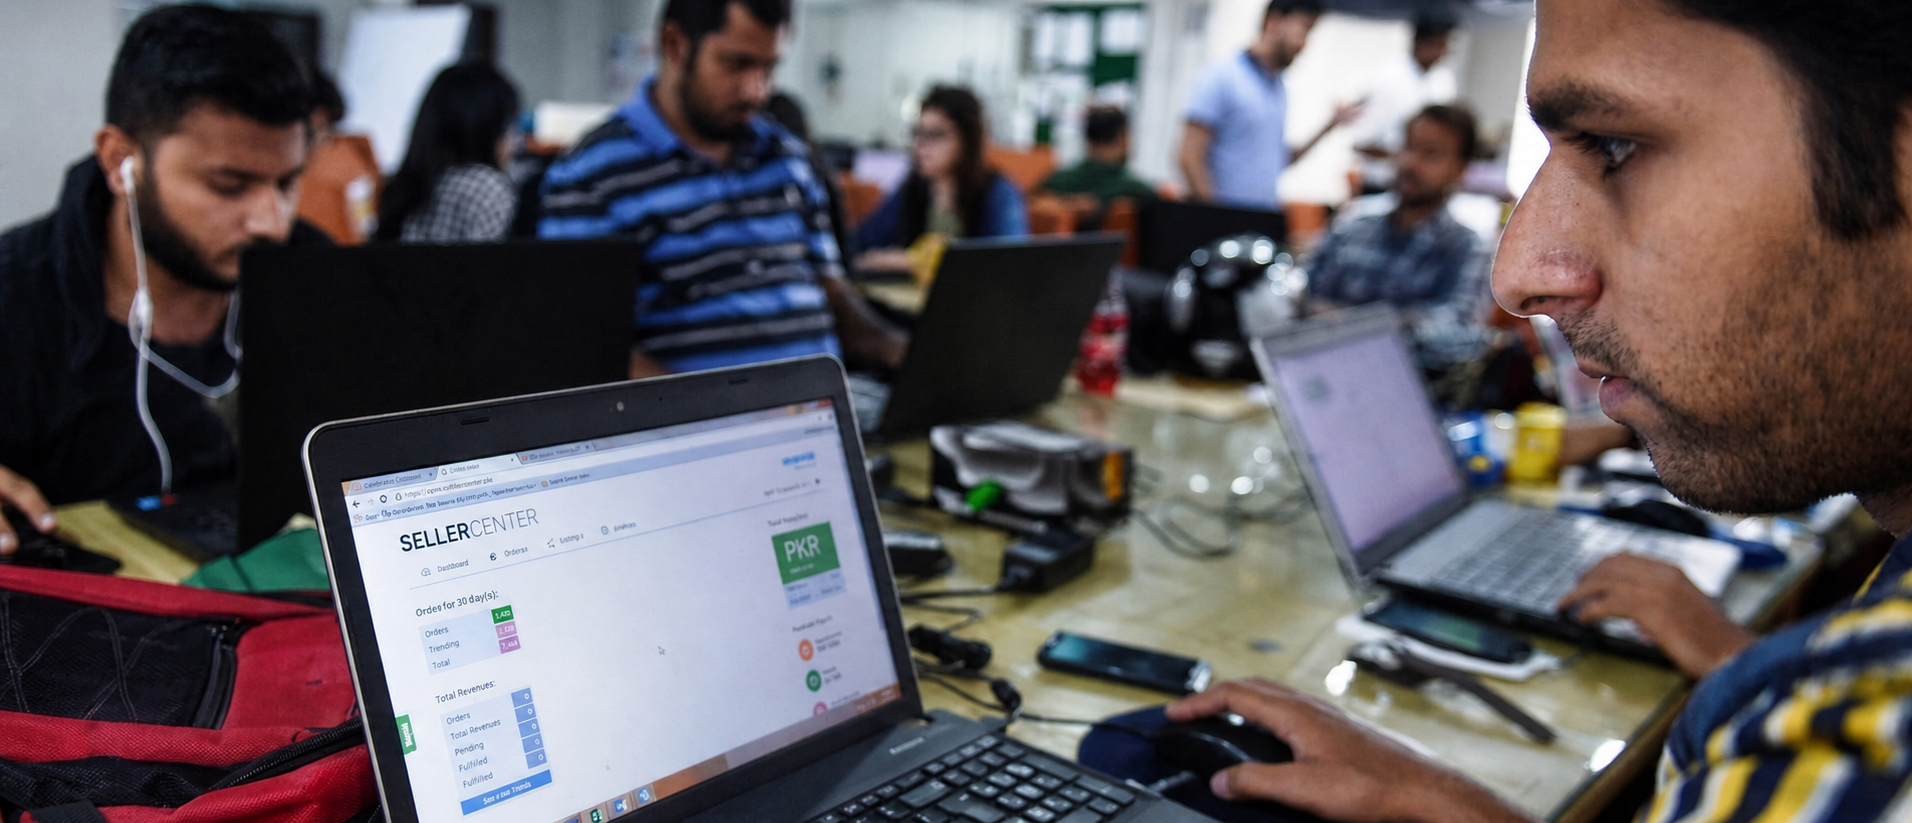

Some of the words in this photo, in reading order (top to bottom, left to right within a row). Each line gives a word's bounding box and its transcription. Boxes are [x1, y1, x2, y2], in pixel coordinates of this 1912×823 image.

[784, 534, 821, 562] PKR
[443, 601, 456, 610] for
[456, 597, 468, 606] 30
[425, 627, 449, 638] Orders
[428, 640, 460, 654] Trending
[432, 658, 451, 669] Total
[435, 691, 457, 704] Total
[446, 712, 471, 725] Orders
[450, 729, 468, 741] Total
[469, 719, 501, 734] Revenues
[454, 742, 485, 757] Pending
